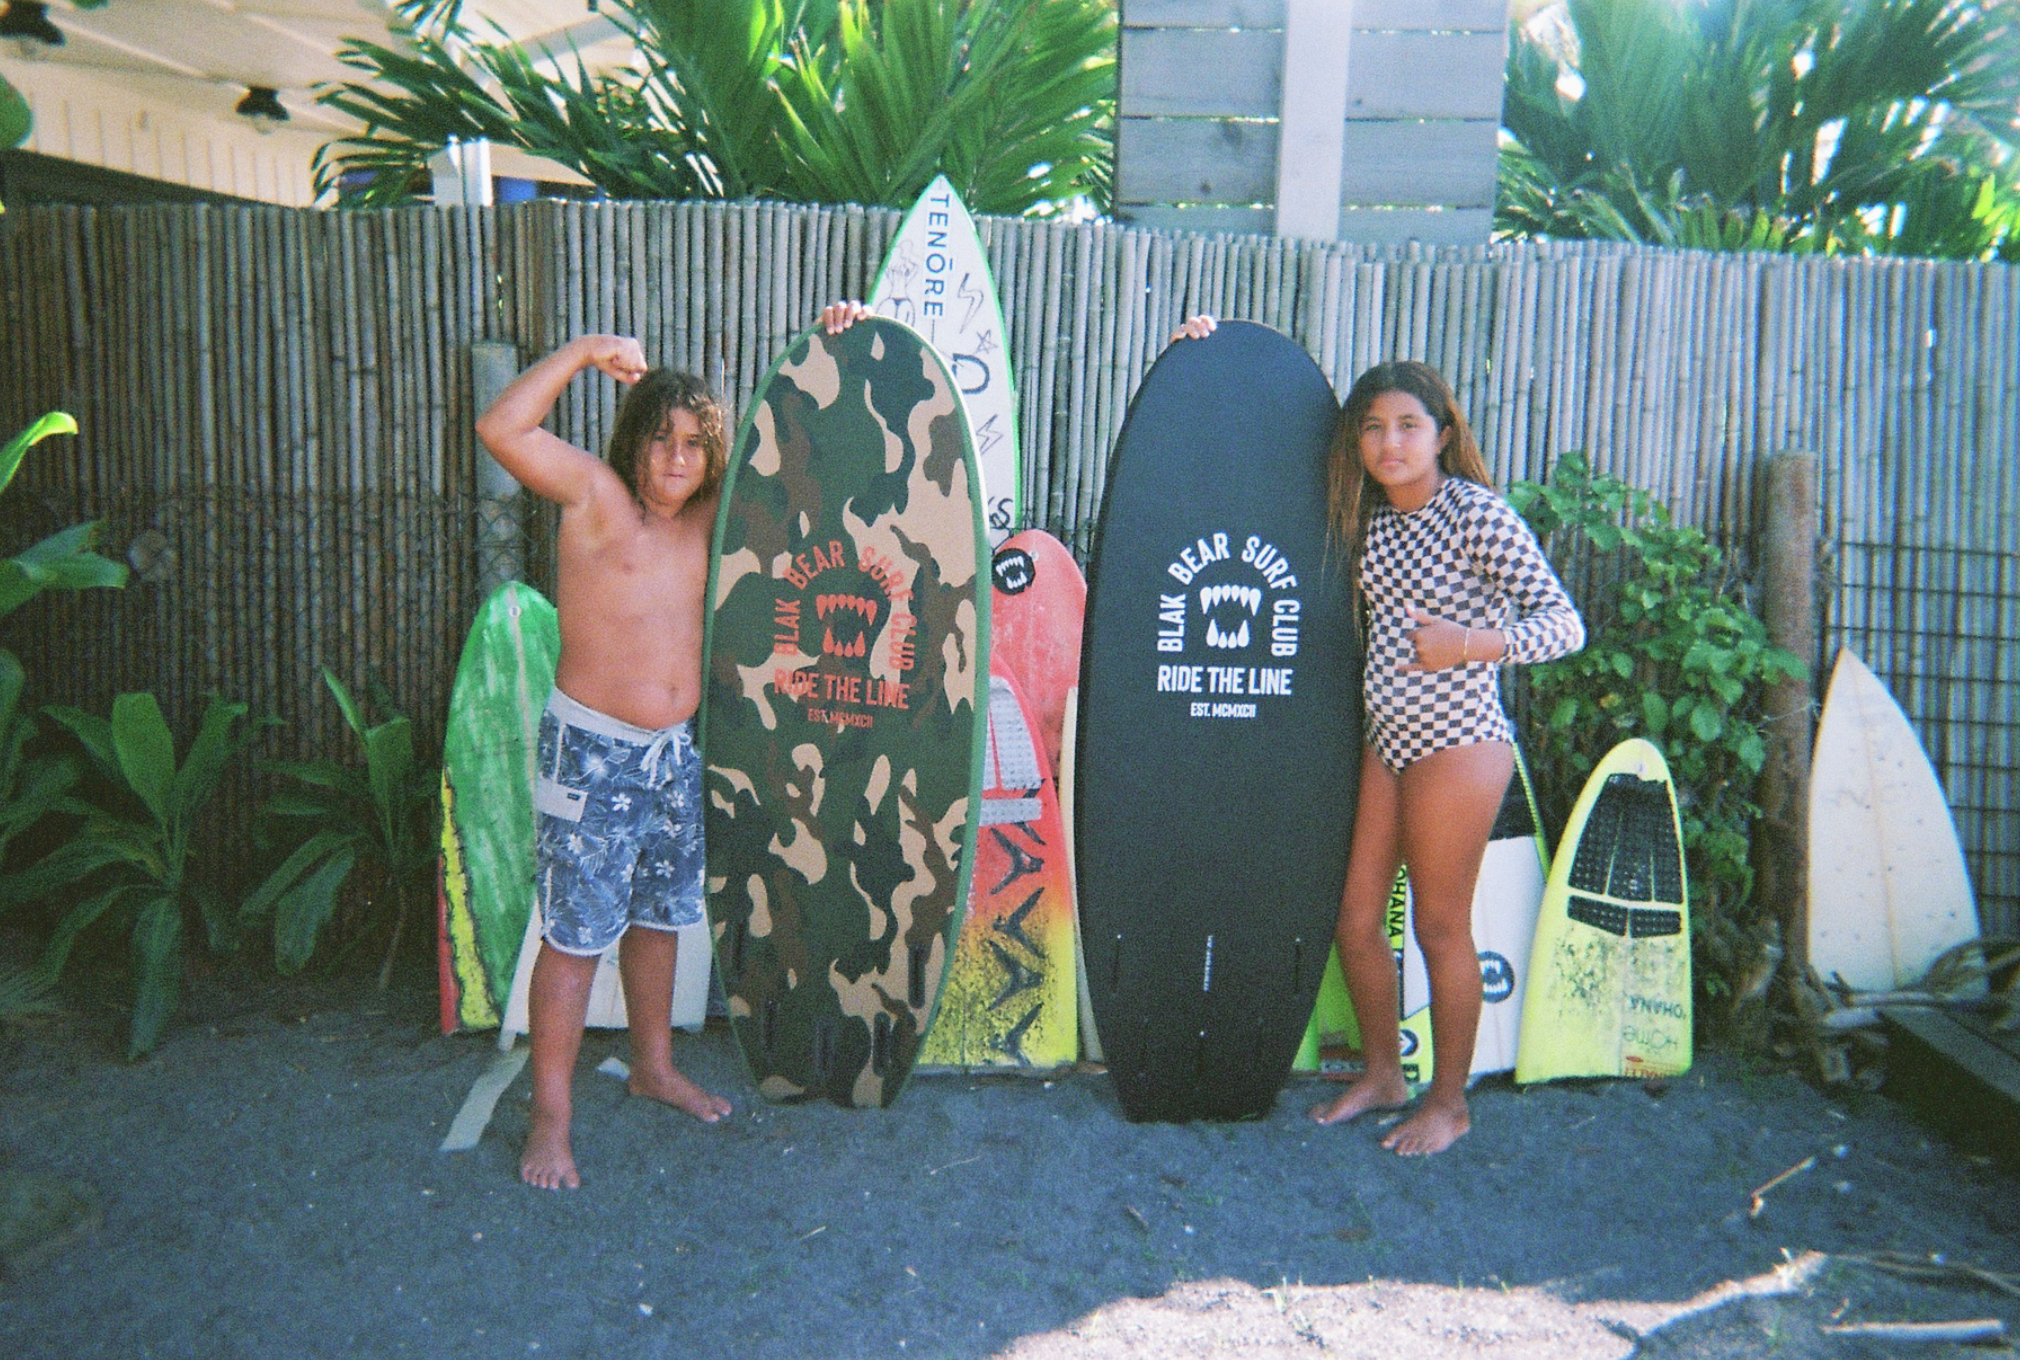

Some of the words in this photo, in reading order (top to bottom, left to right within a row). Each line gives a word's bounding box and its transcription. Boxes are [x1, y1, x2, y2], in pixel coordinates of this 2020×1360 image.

[782, 540, 845, 590] BEAR
[858, 546, 914, 602] SURF
[1167, 532, 1230, 585] BEAR
[1241, 535, 1298, 589] SURF
[773, 598, 801, 656] BLAK
[888, 613, 918, 671] CLUB
[1156, 593, 1186, 652] BLAK
[1270, 599, 1300, 657] CLUB
[773, 668, 819, 699] RIDE
[824, 674, 862, 703] THE
[865, 679, 910, 710] LINE
[1157, 665, 1204, 692] RIDE
[1207, 666, 1245, 694] THE
[1248, 667, 1293, 695] LINE
